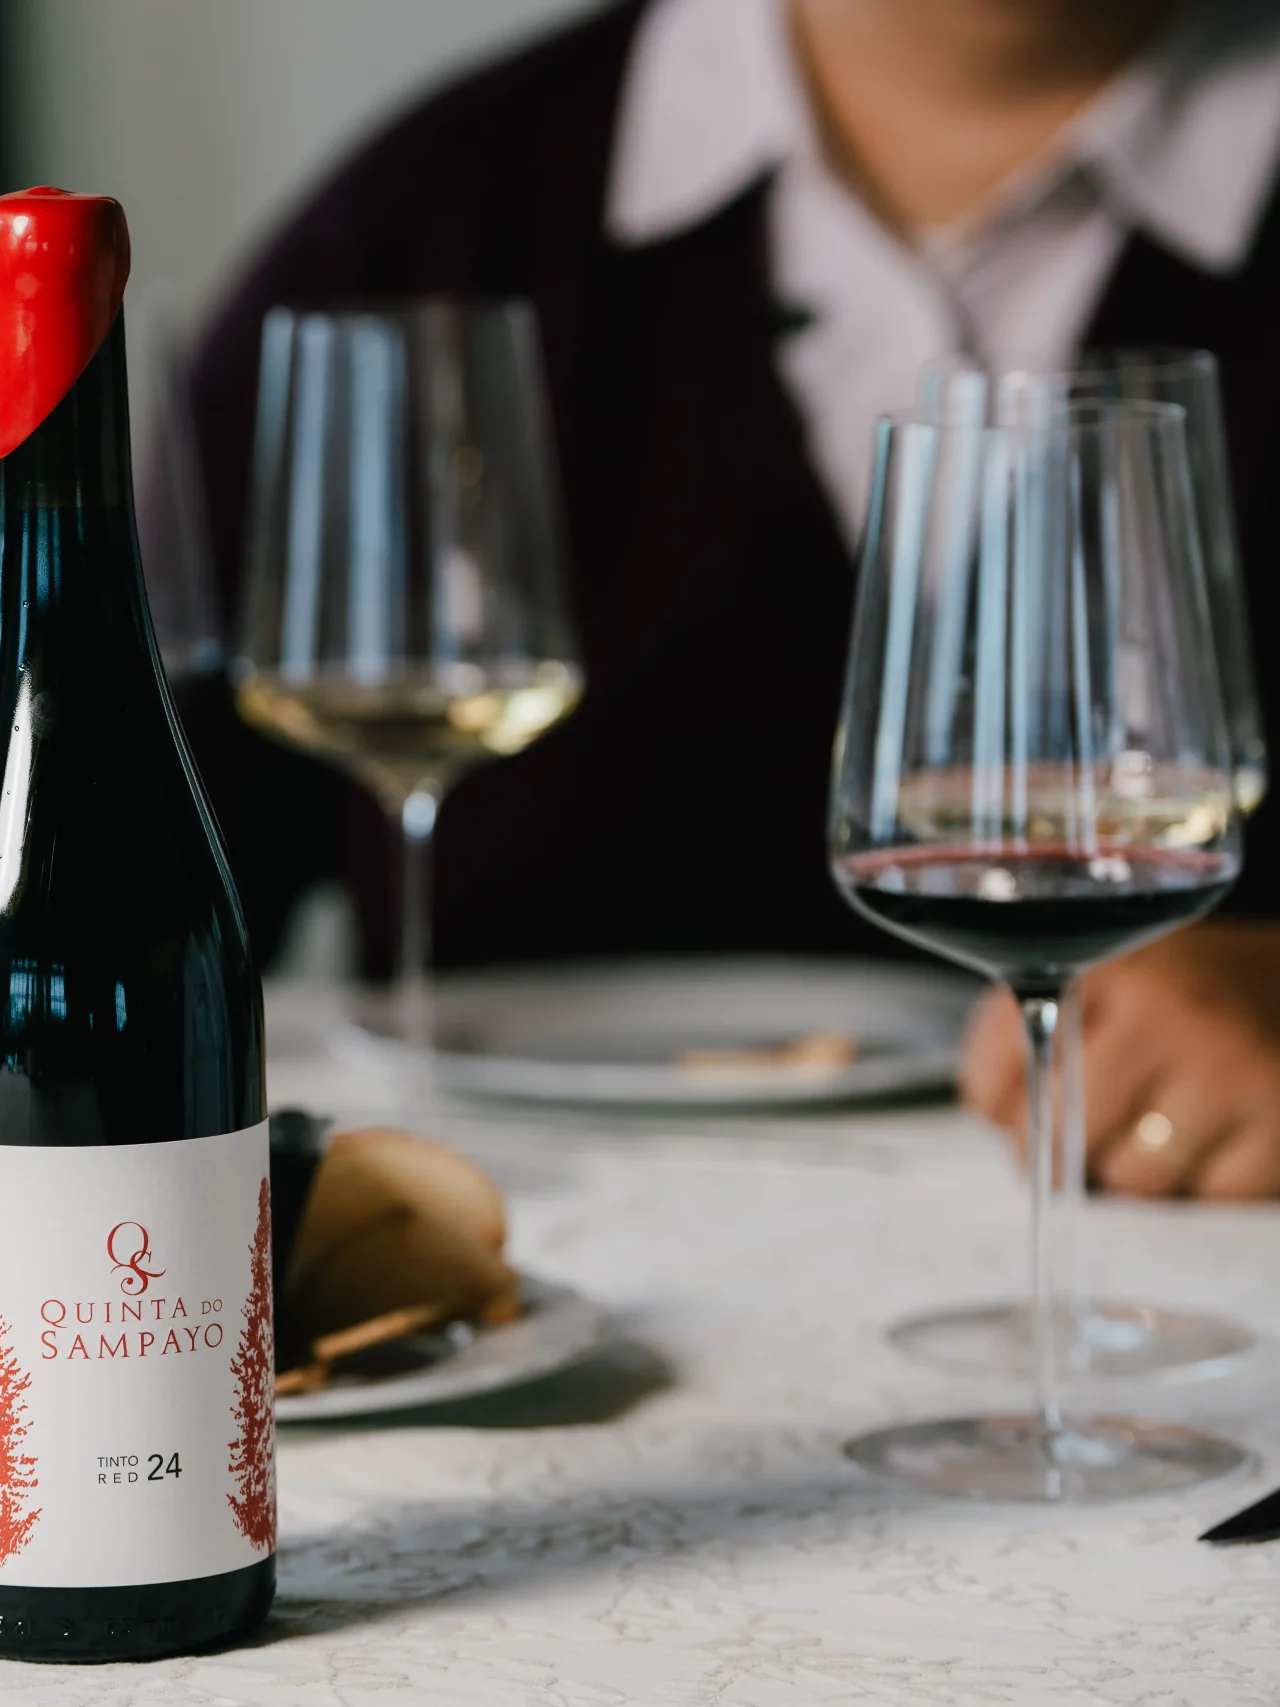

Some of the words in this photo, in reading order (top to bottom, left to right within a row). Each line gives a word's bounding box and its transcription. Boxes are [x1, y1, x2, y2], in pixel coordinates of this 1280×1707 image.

[40, 1296, 189, 1329] QUINTA
[201, 1299, 224, 1315] DO
[40, 1323, 224, 1360] SAMPAYO
[97, 1455, 139, 1468] TINTO
[147, 1452, 183, 1481] 24
[98, 1472, 139, 1485] RED
